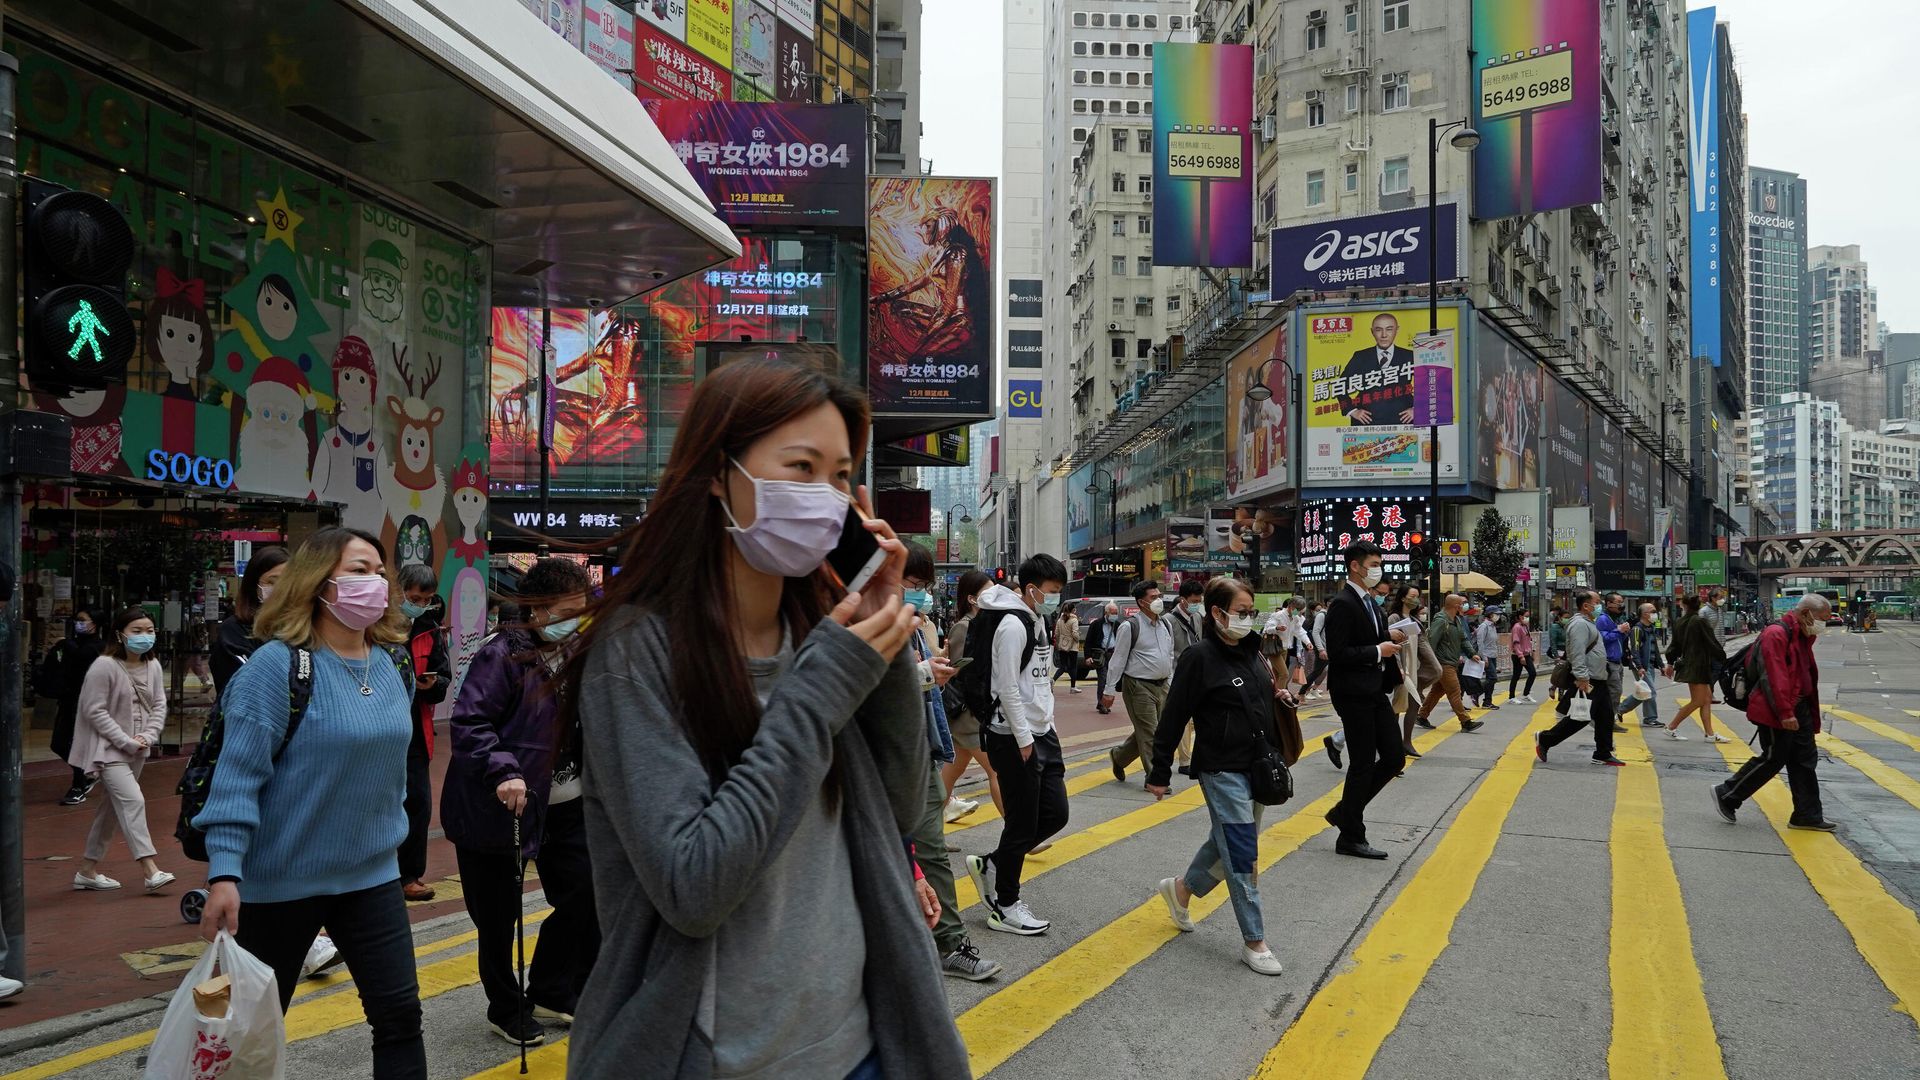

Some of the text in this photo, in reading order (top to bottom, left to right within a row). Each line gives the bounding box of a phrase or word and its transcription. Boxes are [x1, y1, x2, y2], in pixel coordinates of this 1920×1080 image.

[670, 1, 684, 17] 5/F
[719, 22, 730, 37] 5/F
[1484, 77, 1570, 107] 5649 6988
[753, 128, 765, 139] DC
[18, 50, 352, 249] OGETHER
[671, 138, 850, 168] 神奇女俠1984
[1170, 155, 1240, 169] 5649 6988
[708, 168, 809, 177] WONDER WOMAN 1984
[730, 193, 749, 202] 12月
[111, 175, 241, 272] ARE
[362, 202, 409, 238] SOGO
[1709, 152, 1717, 287] 3602 2388
[1748, 211, 1795, 230] Rosedale
[704, 271, 823, 289] 神奇女俠1984
[1328, 261, 1405, 283] 崇光百貨4樓
[717, 304, 809, 316] 12月17日 願望成真
[1316, 318, 1348, 329] 馬百良
[880, 363, 980, 378] 神奇女俠1984
[1313, 361, 1414, 402] 馬百良安宮牛
[148, 449, 234, 489] SOGO
[1351, 504, 1407, 528] 香港
[511, 553, 536, 561] Fashio
[1095, 564, 1123, 572] LUSH
[1447, 564, 1464, 572] 全日
